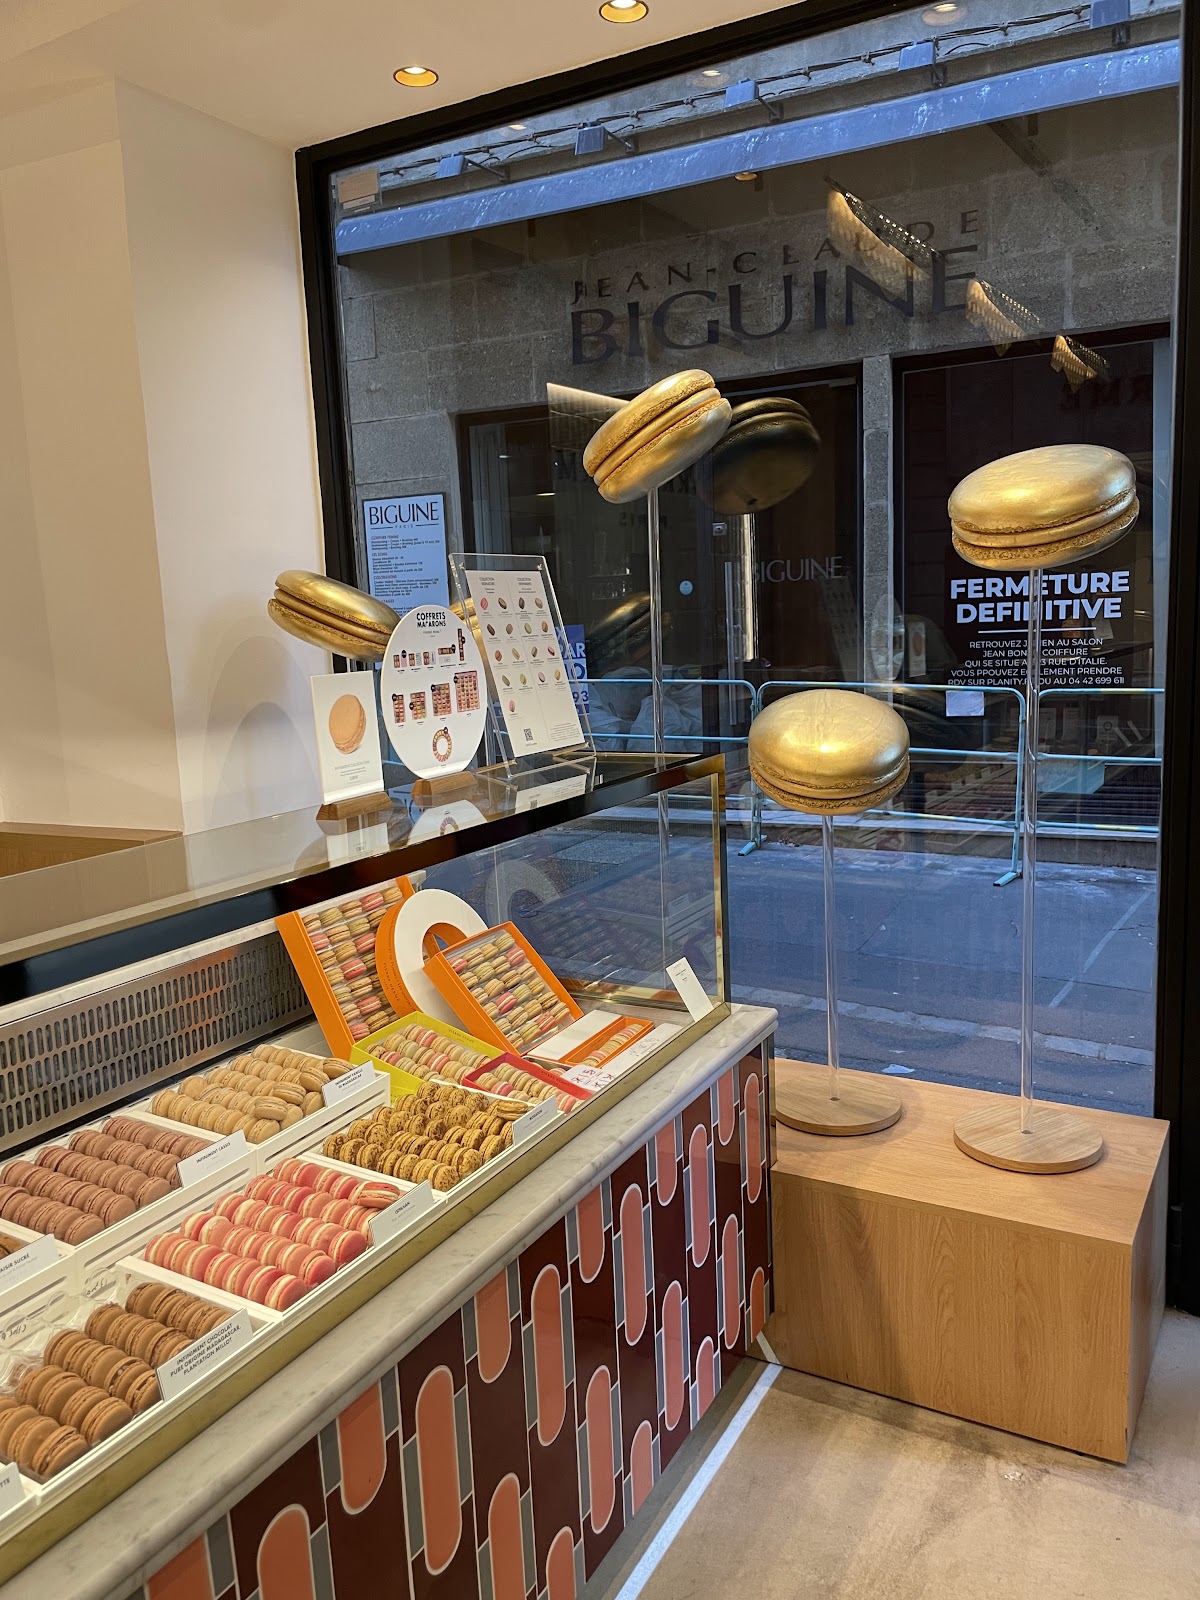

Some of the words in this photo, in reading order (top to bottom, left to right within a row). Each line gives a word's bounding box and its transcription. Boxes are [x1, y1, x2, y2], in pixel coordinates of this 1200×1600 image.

[570, 245, 979, 366] BIGUINE
[369, 502, 440, 525] BIGUINE
[950, 570, 1130, 600] FERMETURE
[416, 612, 446, 621] COFFRETS
[956, 597, 1122, 624] DEFINITIVE
[970, 640, 1021, 648] RETROUVEZ
[965, 660, 980, 668] QUI
[1077, 666, 1122, 675] PRENDRE
[177, 1342, 206, 1365] INFINIMENT
[207, 1323, 232, 1344] CHOCOLAT
[184, 1350, 215, 1375] PLANTATION
[215, 1337, 232, 1352] MILLOT
[170, 1366, 183, 1377] PURE
[184, 1350, 206, 1367] ORIGINE
